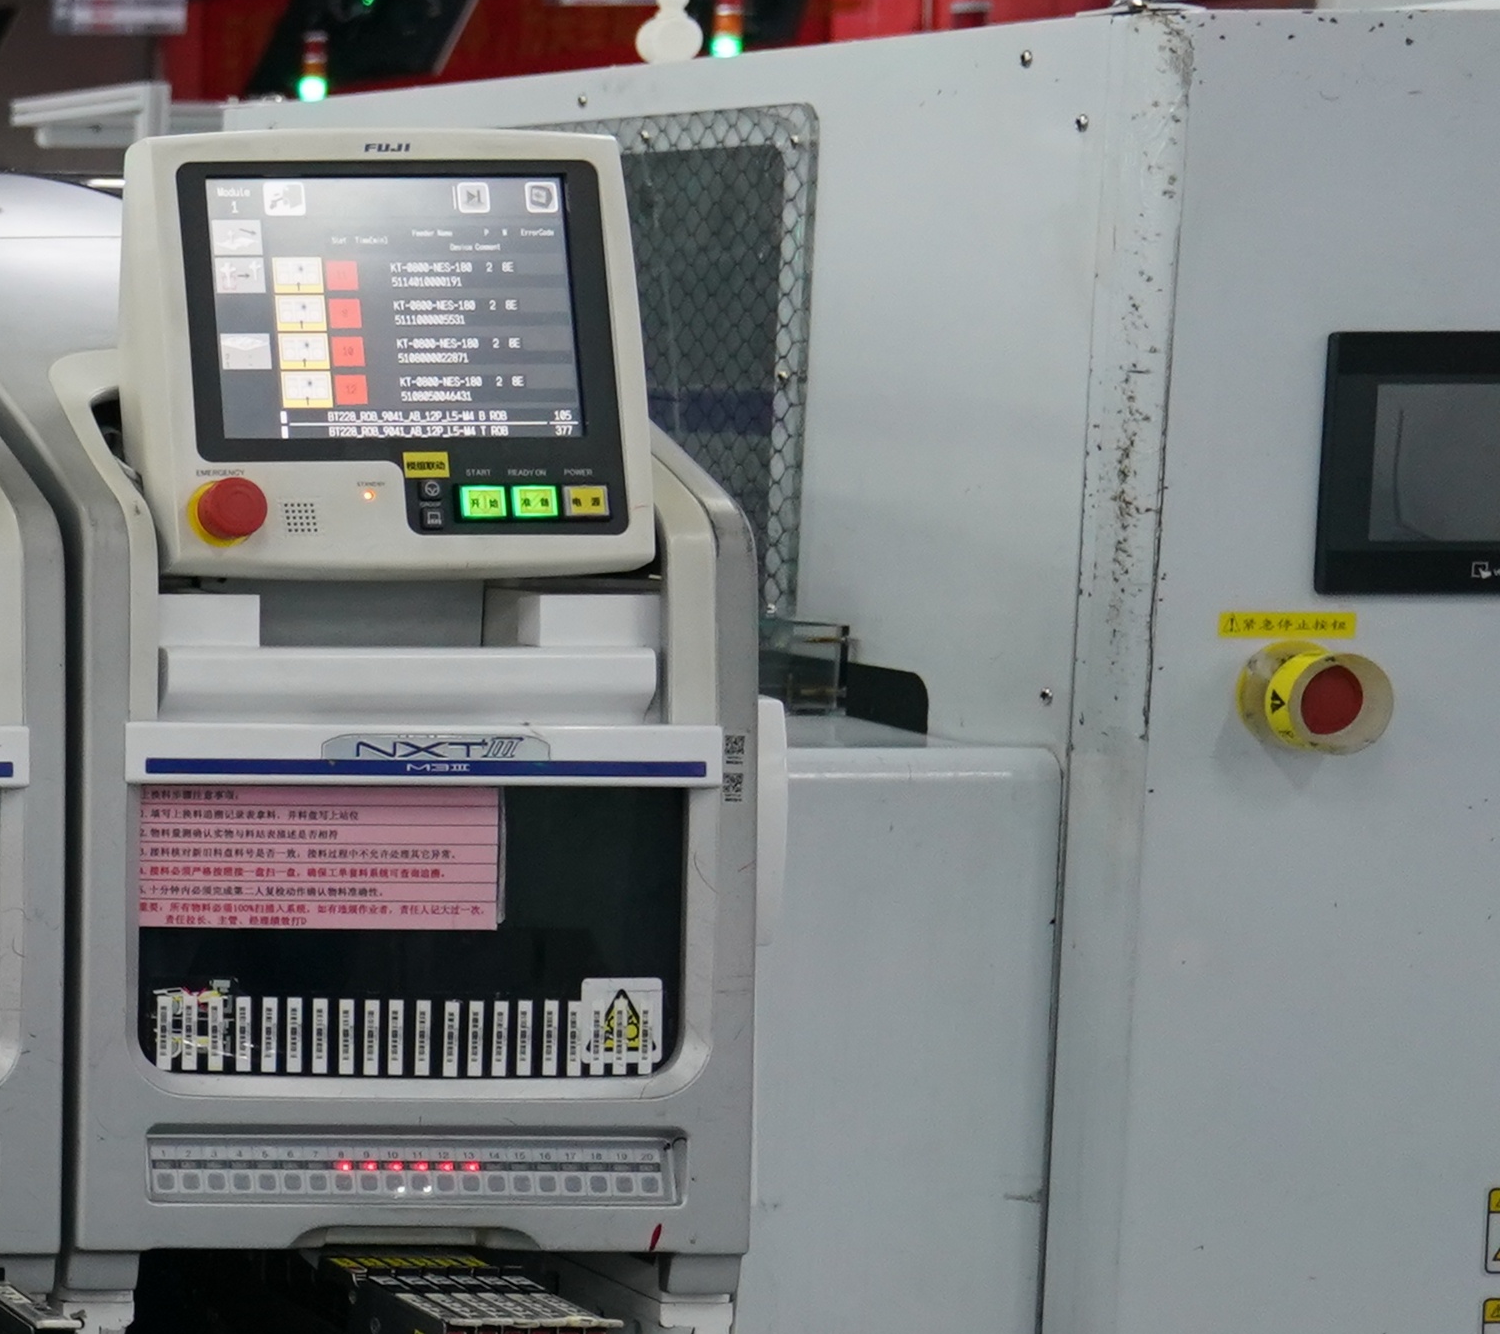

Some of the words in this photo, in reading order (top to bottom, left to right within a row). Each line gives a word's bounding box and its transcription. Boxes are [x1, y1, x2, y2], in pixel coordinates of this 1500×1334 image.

[364, 141, 411, 152] FUJI
[217, 188, 250, 198] Module
[231, 201, 239, 213] 1
[196, 469, 245, 477] EMERGENCY
[465, 468, 491, 476] START
[564, 468, 592, 476] POWER
[1242, 619, 1348, 631] 紧急停止按钮
